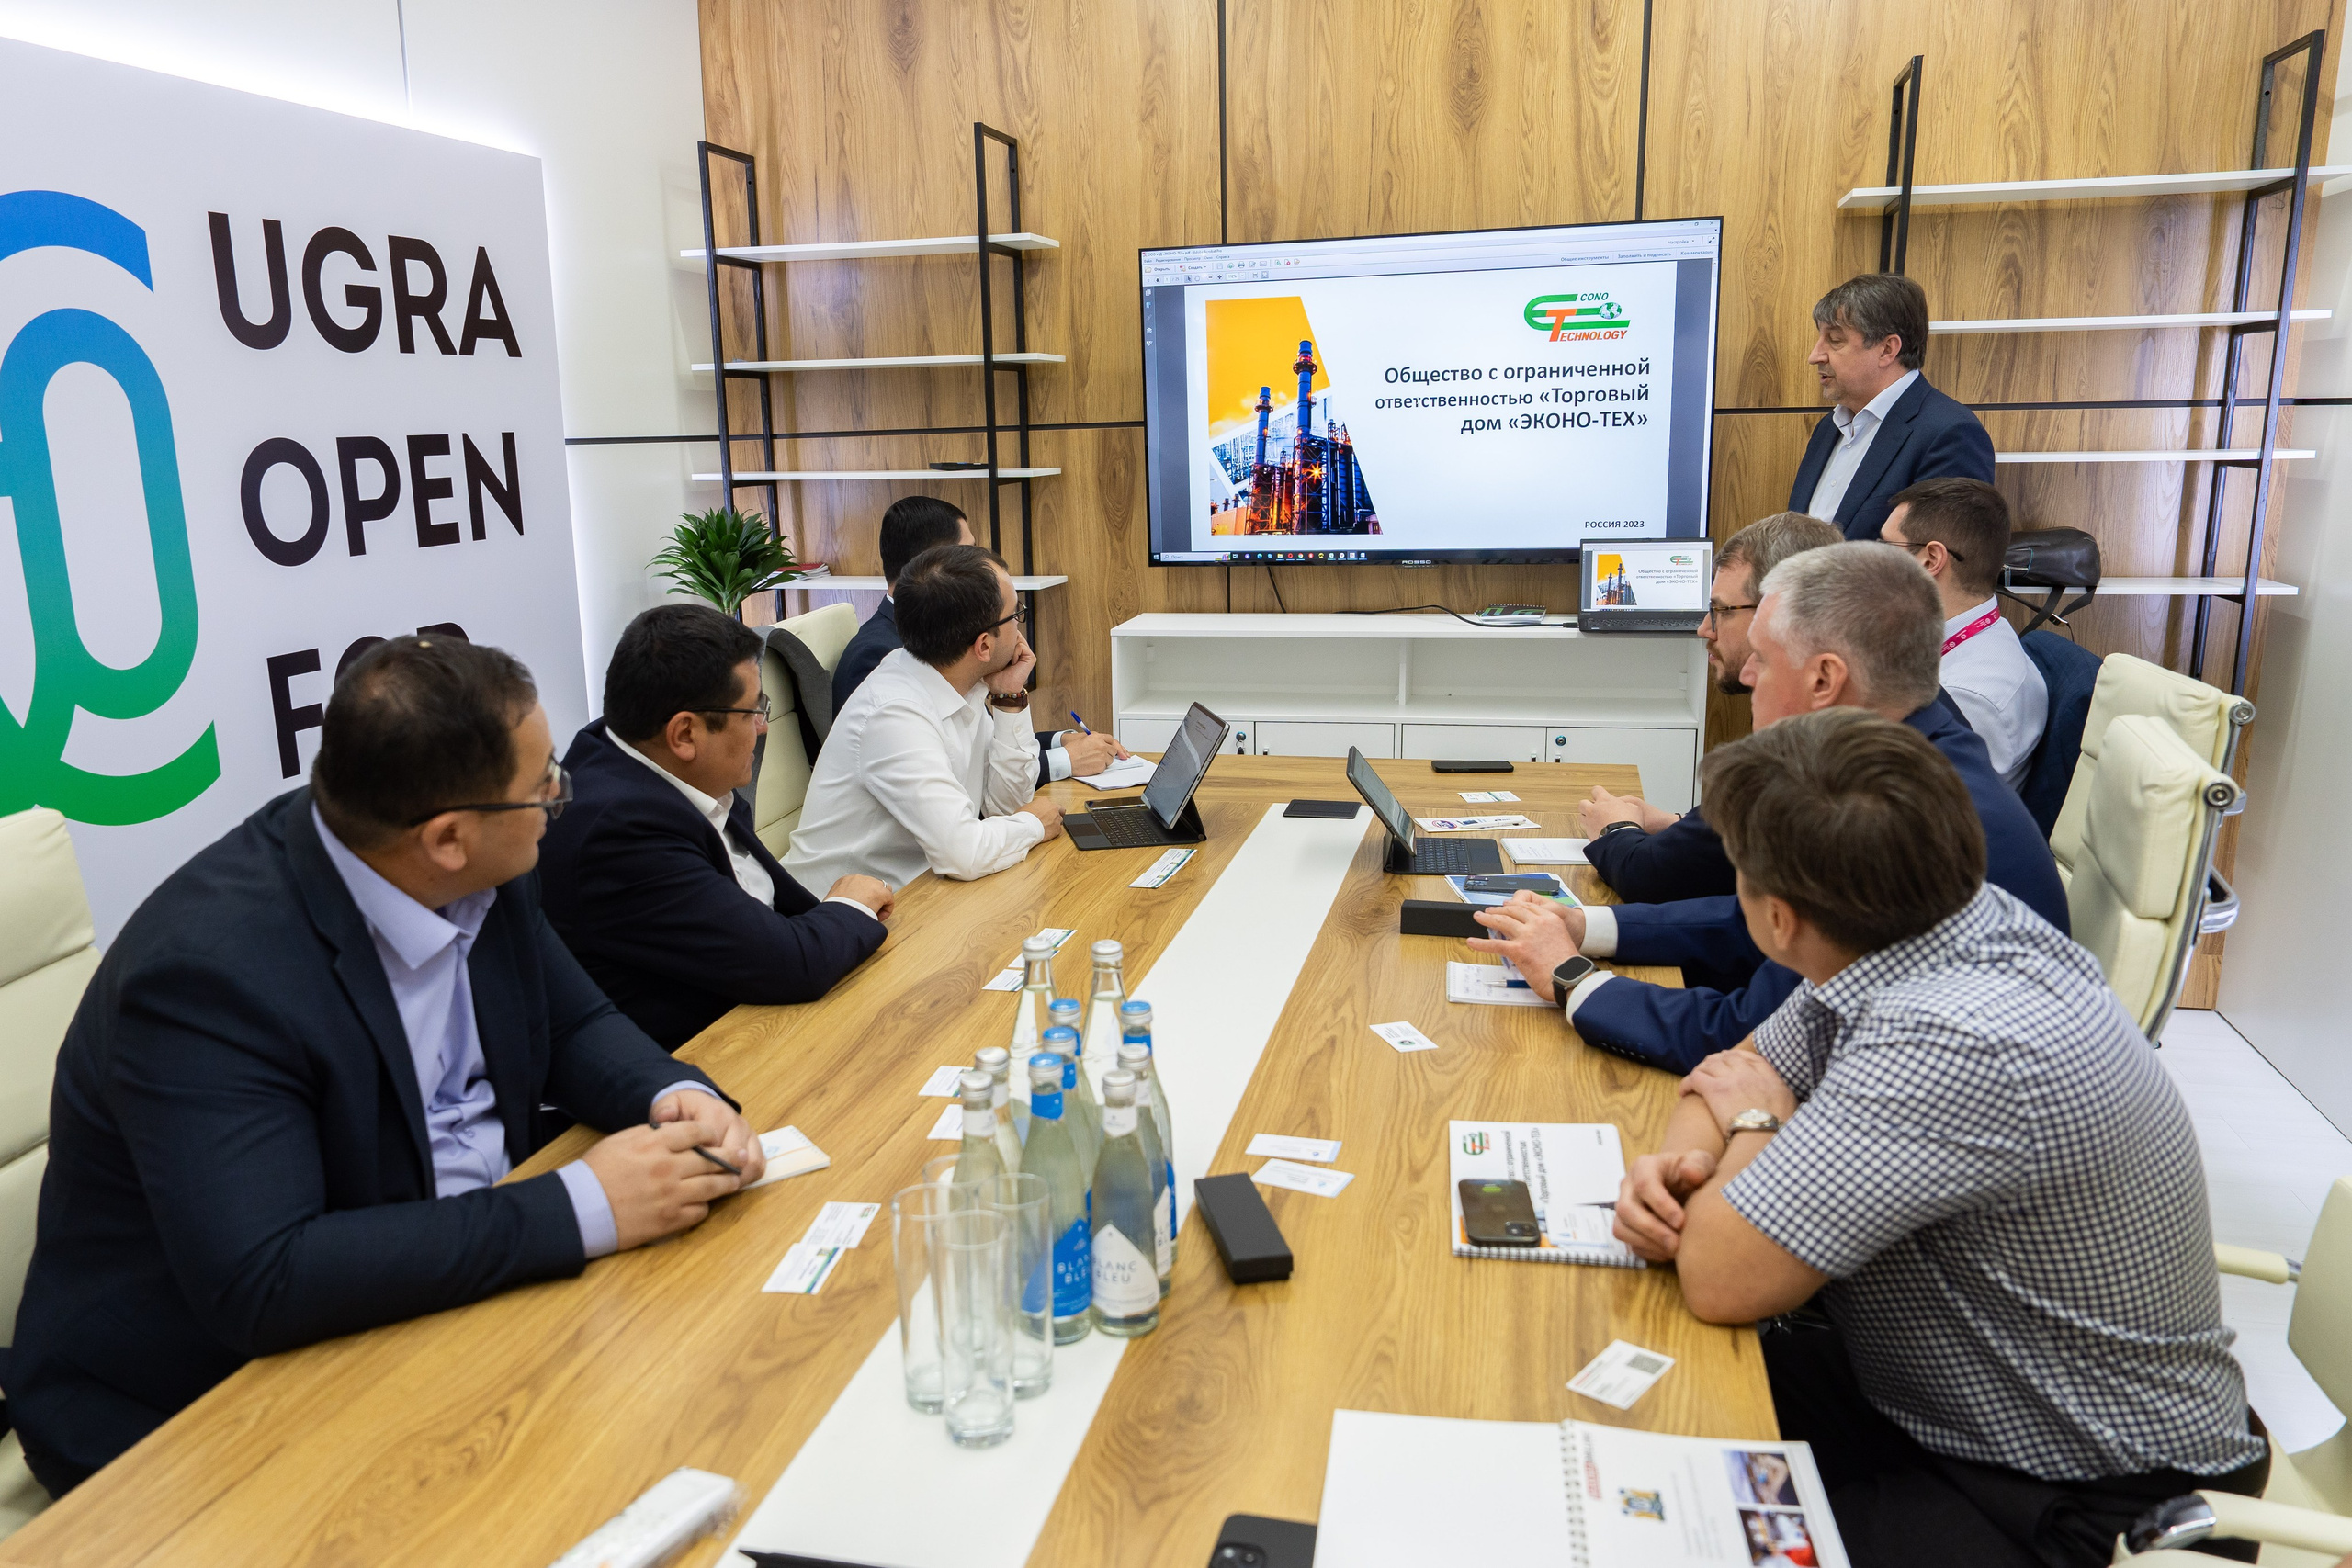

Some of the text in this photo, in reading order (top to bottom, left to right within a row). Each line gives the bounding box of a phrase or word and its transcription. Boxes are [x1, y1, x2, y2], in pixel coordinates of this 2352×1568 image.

[208, 211, 523, 358] UGRA
[1385, 357, 1650, 386] Общество с ограниченной
[1374, 383, 1649, 410] ответственностью «Торговый
[1460, 410, 1648, 434] дом «ЭКОНО-ТЕХ»
[241, 432, 525, 567] OPEN
[1623, 520, 1645, 528] 2023
[1096, 1268, 1131, 1284] BLEU
